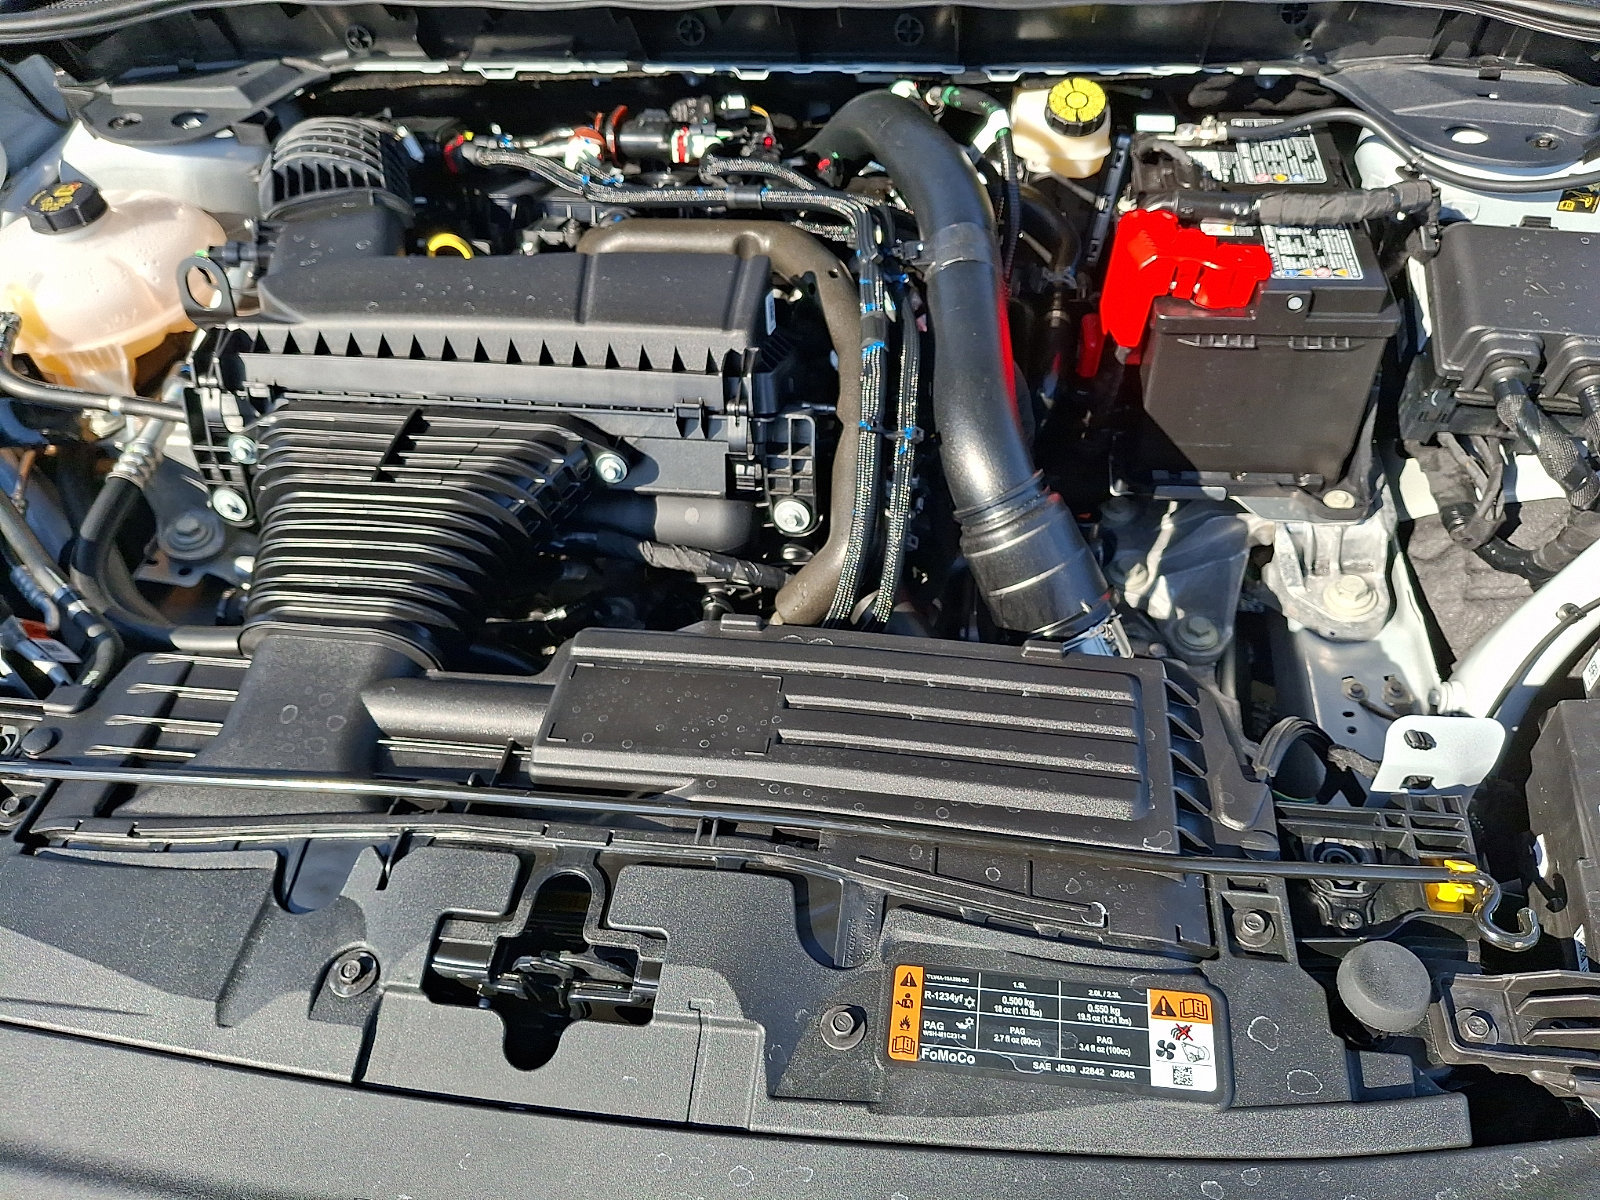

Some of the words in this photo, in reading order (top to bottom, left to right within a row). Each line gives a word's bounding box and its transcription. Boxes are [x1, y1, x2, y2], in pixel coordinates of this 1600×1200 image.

[924, 990, 964, 1004] R-1234yf
[1001, 996, 1023, 1006] 0.500
[1024, 997, 1035, 1009] kg
[1012, 1006, 1029, 1016] (1.10
[1029, 1008, 1043, 1018] lbs)
[1087, 1003, 1109, 1014] 0.550
[1110, 1005, 1121, 1017] kg
[923, 1020, 945, 1031] PAG
[1101, 1014, 1117, 1024] (1.21
[1118, 1017, 1132, 1027] lbs)
[1009, 1026, 1026, 1036] PAG
[993, 1034, 1004, 1042] 2.7
[1004, 1035, 1011, 1043] fl
[1096, 1035, 1113, 1045] PAG
[921, 1047, 976, 1065] FoMoCo
[1078, 1043, 1090, 1052] 3.4
[1090, 1044, 1096, 1053] fl
[1105, 1046, 1131, 1057] (100cc)
[1032, 1061, 1052, 1072] SAE
[1055, 1063, 1076, 1073] J639
[1079, 1066, 1105, 1076] J2842
[1109, 1069, 1136, 1080] J2845
